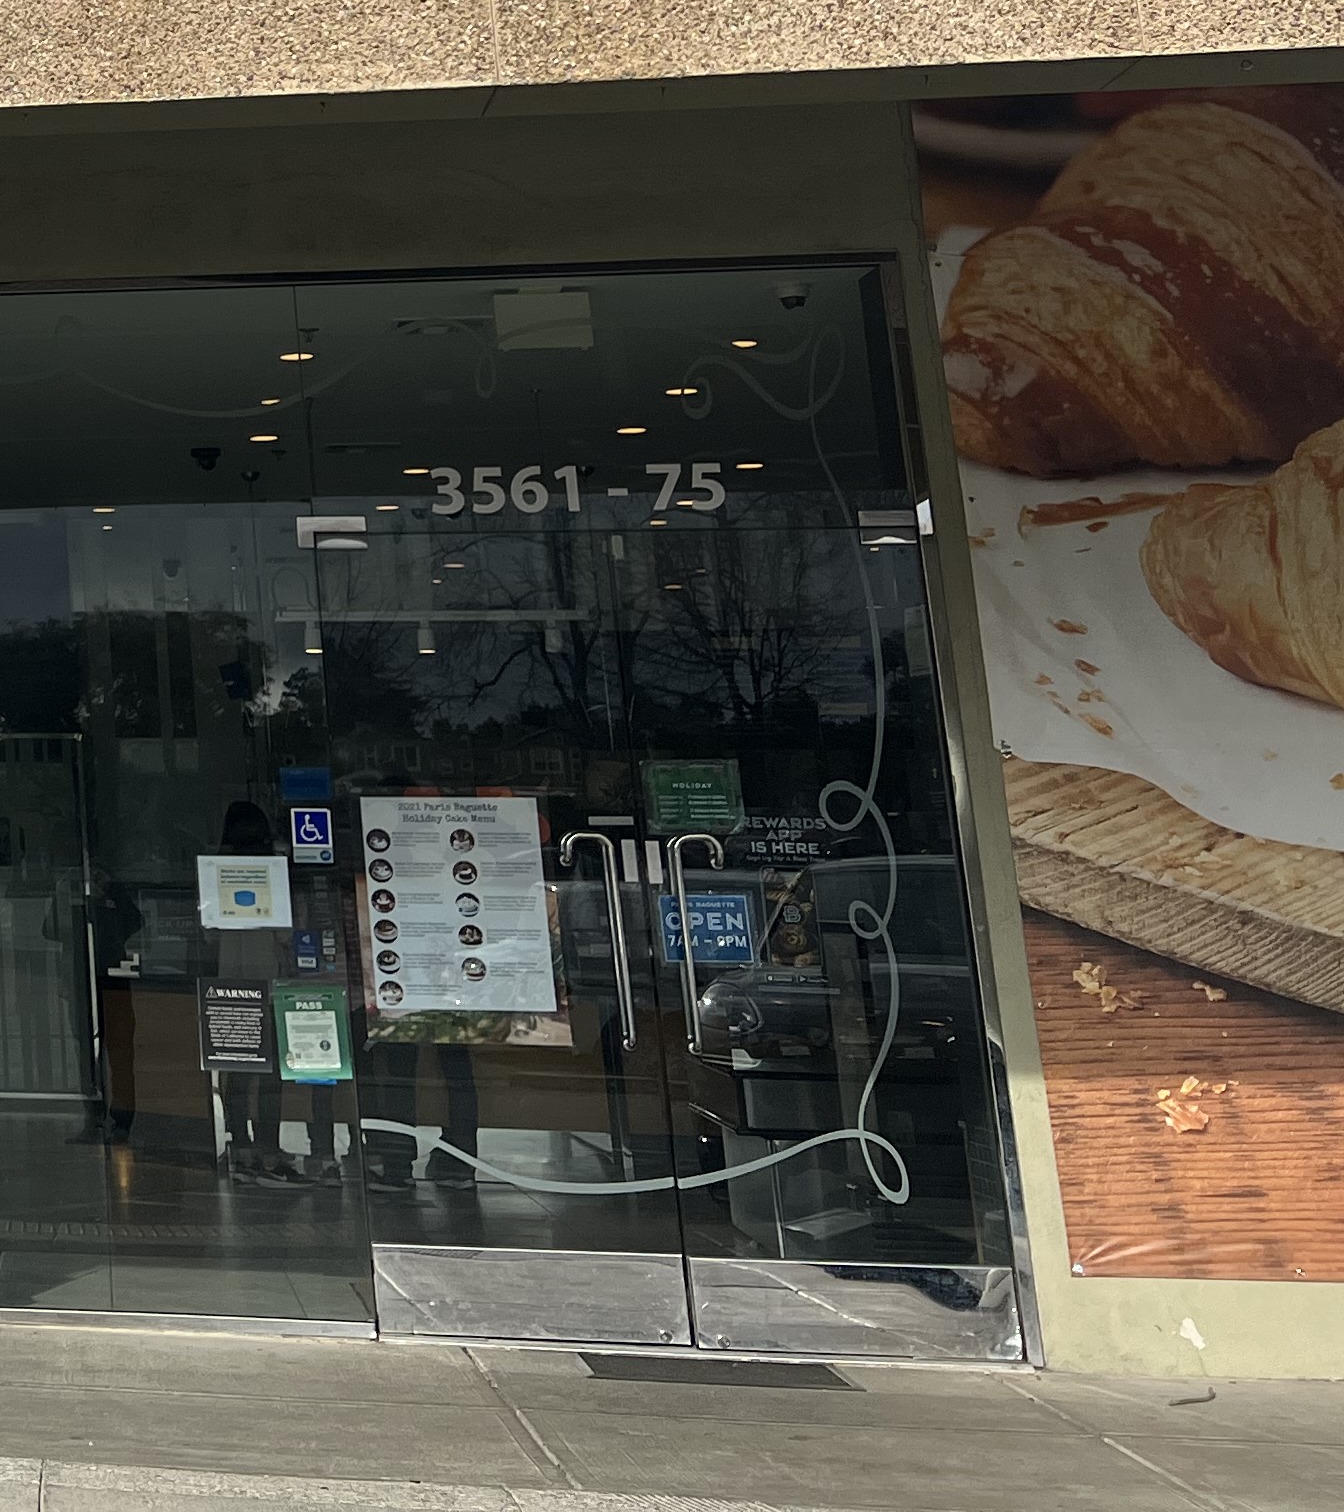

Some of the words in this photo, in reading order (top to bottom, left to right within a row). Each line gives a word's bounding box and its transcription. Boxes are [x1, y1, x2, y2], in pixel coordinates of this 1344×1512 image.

[430, 465, 580, 515] 3561
[645, 463, 726, 510] 75
[398, 802, 421, 811] 2021
[424, 802, 450, 811] Paris
[453, 802, 498, 813] Baguette
[402, 814, 443, 824] Holiday
[445, 814, 468, 823] Cake
[471, 814, 496, 823] Menu
[742, 816, 827, 830] REWARDS
[766, 829, 802, 841] APP
[750, 841, 767, 853] IS
[771, 841, 820, 855] HERE
[665, 912, 744, 931] OPEN
[216, 988, 262, 999] WARNING
[295, 1001, 323, 1010] PASS
